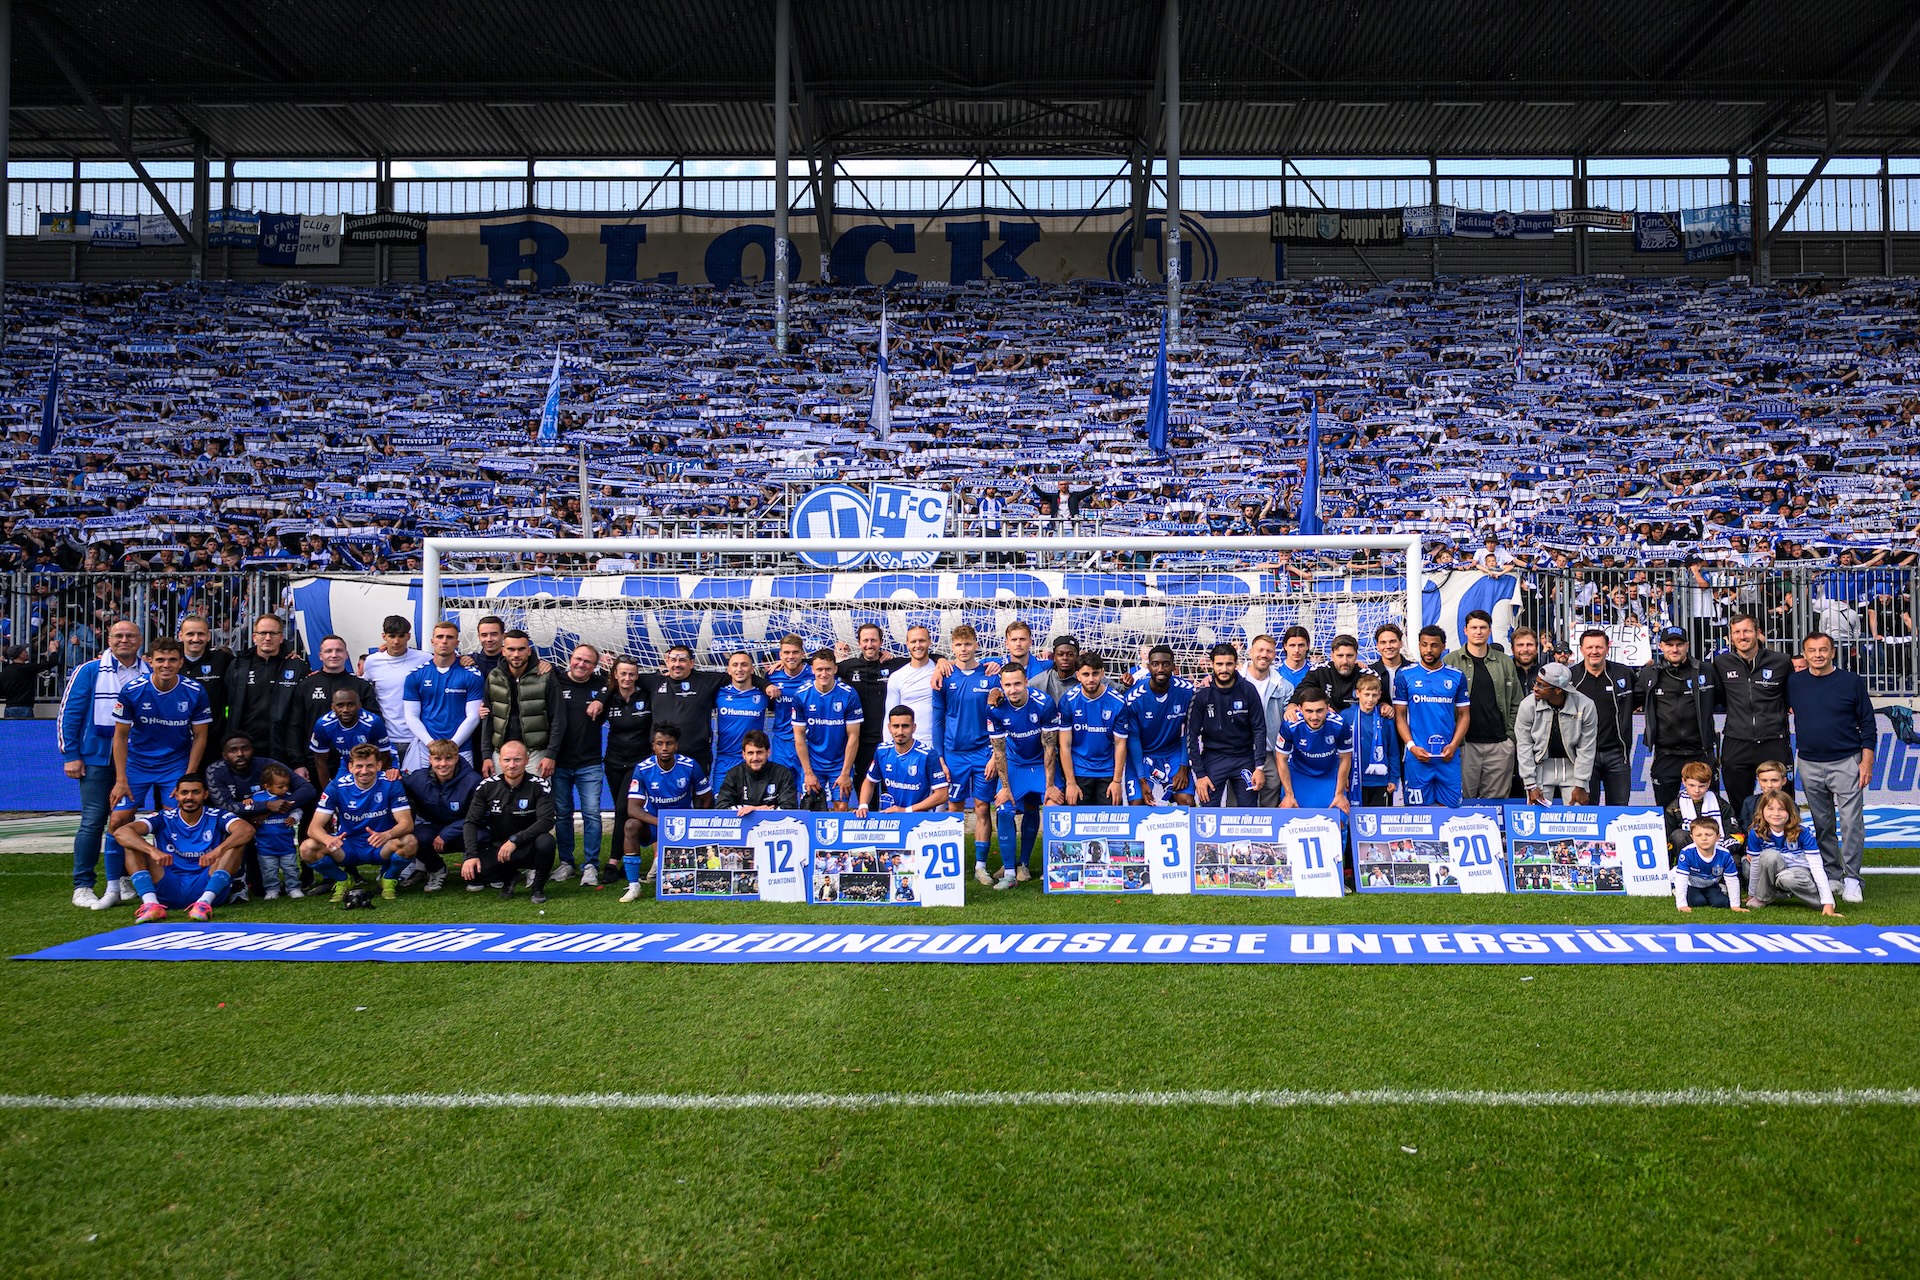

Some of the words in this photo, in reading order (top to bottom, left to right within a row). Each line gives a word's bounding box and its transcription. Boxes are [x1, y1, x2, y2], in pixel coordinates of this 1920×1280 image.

[303, 221, 330, 232] CLUB
[1640, 214, 1678, 228] Fancb
[1341, 214, 1400, 244] supporter
[93, 231, 138, 240] ADLER
[279, 243, 320, 253] REFORM
[1641, 239, 1668, 249] BLOCK
[876, 493, 941, 523] 1.FC
[1597, 547, 1638, 556] MAGDEBU
[727, 707, 761, 716] Humanas
[149, 716, 188, 727] Humanas
[816, 718, 844, 726] Humanas
[890, 780, 920, 791] Humanas
[1127, 779, 1135, 796] 3
[1407, 788, 1424, 804] 20
[351, 808, 387, 822] Humanas
[1075, 812, 1097, 823] DANKE
[1097, 811, 1109, 823] FÜR
[1109, 812, 1130, 823] ALLES!
[1220, 815, 1240, 825] DANKE
[1240, 814, 1252, 825] FÜR
[1253, 815, 1273, 825] ALLES!
[1380, 814, 1400, 824] DANKE
[1400, 812, 1412, 824] FÜR
[1412, 814, 1432, 824] ALLES!
[1539, 812, 1562, 823] DANKE
[1562, 810, 1576, 823] FÜR
[1576, 812, 1598, 823] ALLES!
[689, 817, 710, 828] DANKE
[710, 815, 722, 828] FÜR
[722, 817, 742, 828] ALLES!
[843, 819, 865, 830] DANKE
[865, 817, 877, 830] FÜR
[877, 819, 900, 830] ALLES!
[1157, 821, 1189, 830] MAGDEBURG
[1628, 822, 1663, 831] MAGDEBURG
[768, 828, 798, 836] MAGDEBURG
[929, 829, 962, 838] MAGDEBURG
[1299, 825, 1329, 833] MAGDEBURG
[868, 833, 886, 841] BURCU
[1160, 833, 1180, 868] 3
[1298, 836, 1324, 869] 11
[1454, 834, 1492, 867] 20
[1632, 835, 1657, 869] 8
[765, 839, 794, 874] 12
[922, 842, 961, 880] 29
[1162, 871, 1188, 879] PFEIFFER
[1468, 869, 1492, 877] AMAECHI
[1632, 874, 1659, 883] TEIXEIRA
[1660, 873, 1668, 881] JR
[768, 877, 796, 885] D'ANTONIO
[935, 882, 955, 891] BURCU
[96, 930, 374, 952] DANKE
[337, 927, 505, 952] FÜR
[483, 932, 679, 953] EURE
[665, 932, 1267, 954] BEDINGUNGSLOSE
